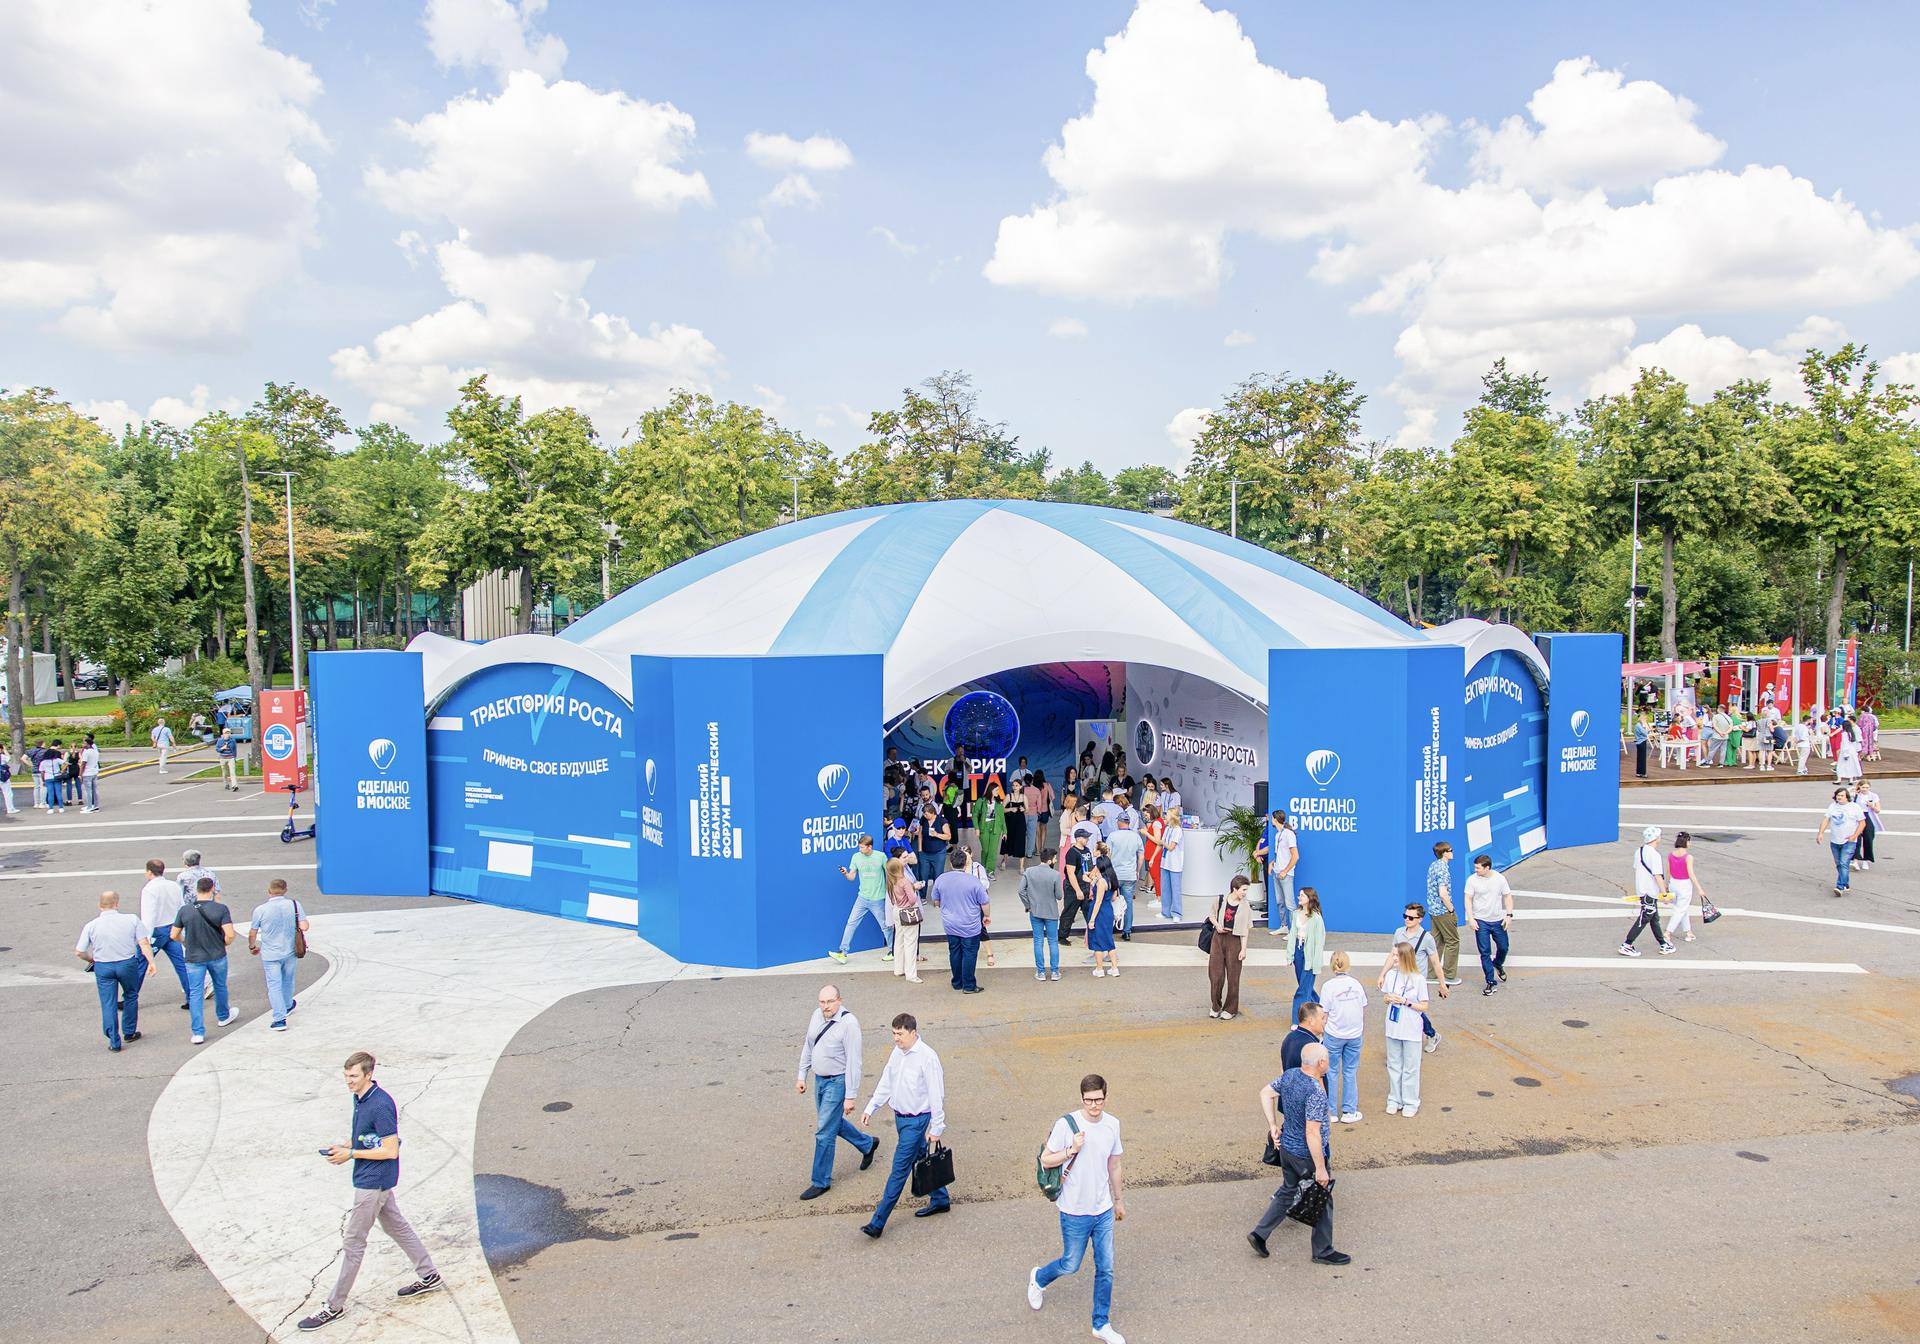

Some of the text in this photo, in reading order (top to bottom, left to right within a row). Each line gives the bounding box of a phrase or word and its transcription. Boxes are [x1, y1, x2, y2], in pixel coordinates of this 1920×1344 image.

[1465, 676, 1522, 704] ЕКТОРИЯ РОСТА
[470, 694, 622, 738] ТРАЕКТОРИЯ РОСТА
[483, 748, 609, 777] ПРИМЕРЬ СВОЕ БУДУЩЕЕ
[1161, 733, 1256, 766] ТРАЕКТОРИЯ РОСТА
[1561, 745, 1597, 760] СДЕЛАНО
[1431, 706, 1440, 831] УРБАНИСТИЧЕСКИЙ
[1561, 758, 1597, 772] В МОСКВЕ
[357, 780, 409, 796] СДЕЛАНО
[707, 722, 720, 857] УРБАНИСТИЧЕСКИЙ
[1423, 745, 1431, 832] МОСКОВСКИЙ
[357, 796, 411, 810] В МОСКВЕ
[697, 763, 710, 857] МОСКОВСКИЙ
[1289, 797, 1356, 815] СДЕЛАНО
[722, 807, 731, 858] ФОРУМ
[802, 812, 864, 837] СДЕЛАНО
[1289, 815, 1358, 832] В МОСКВЕ
[801, 838, 811, 855] В
